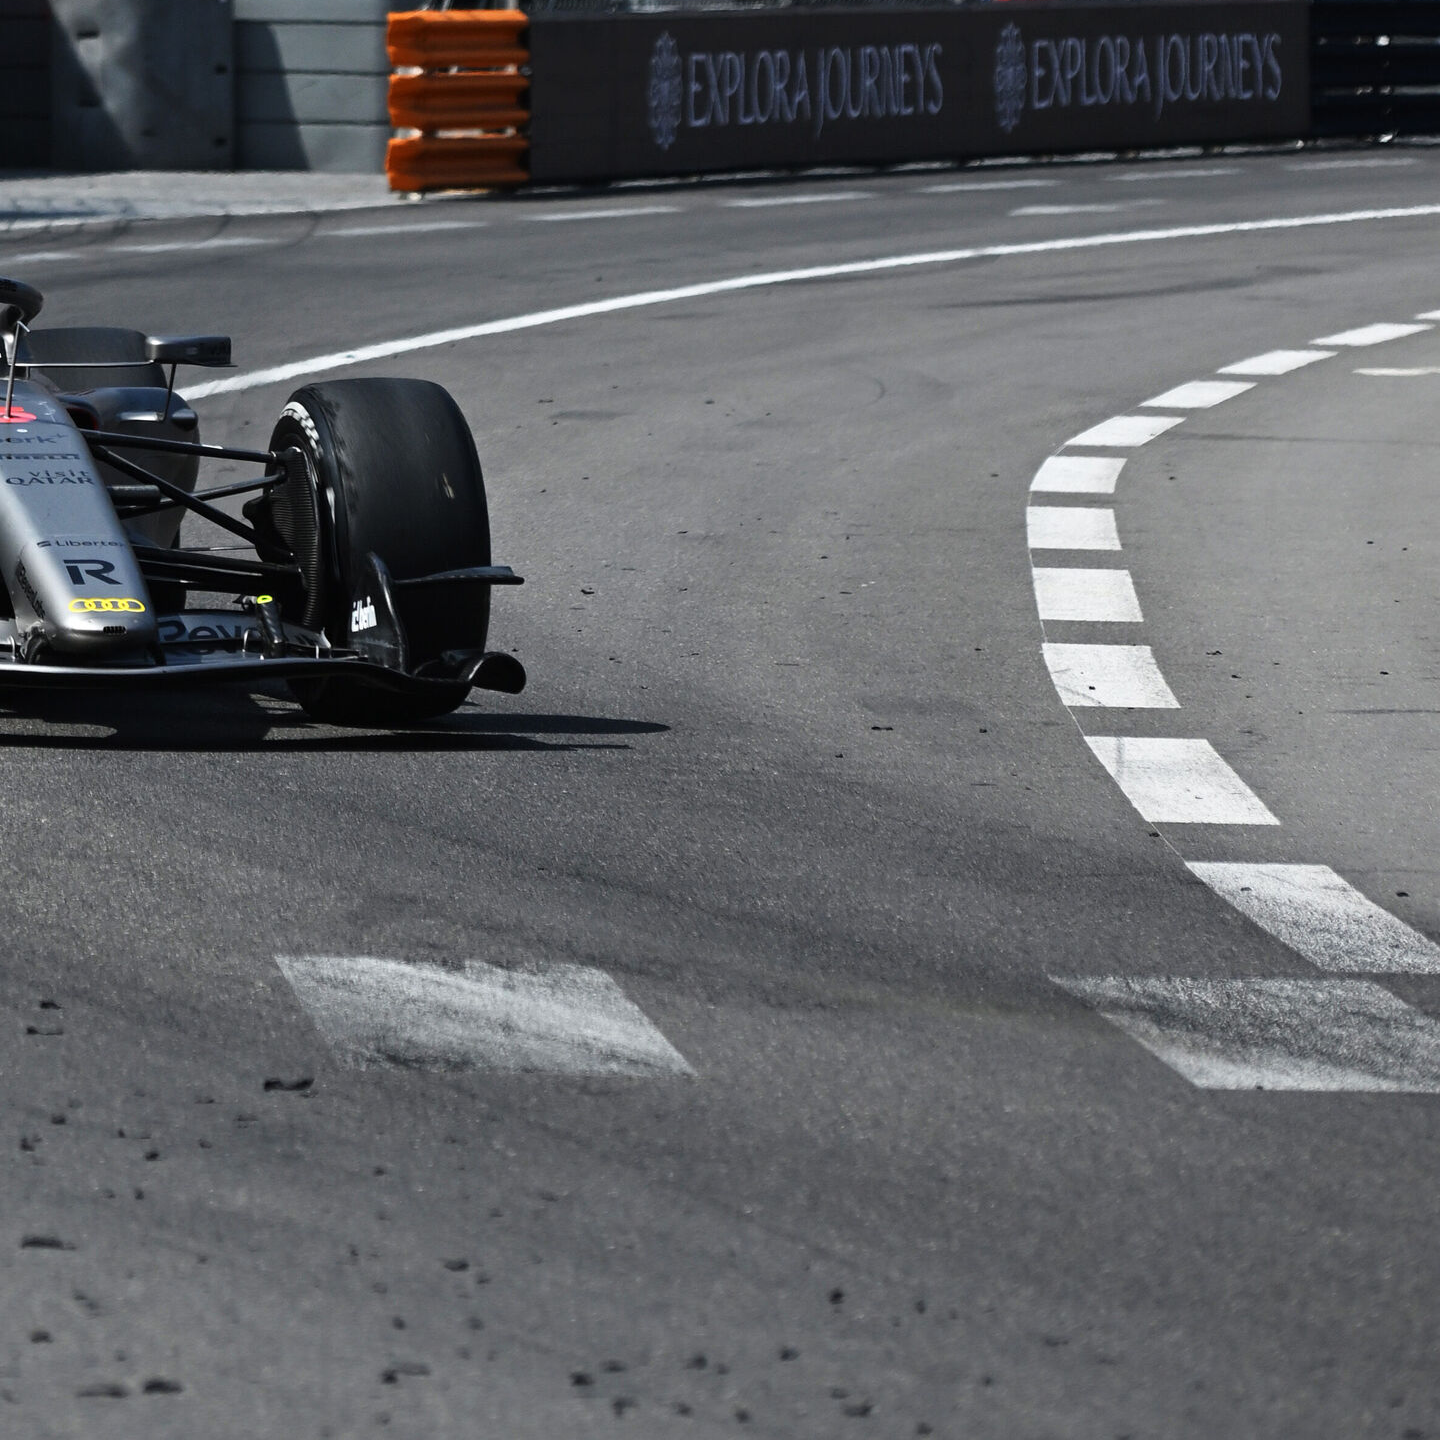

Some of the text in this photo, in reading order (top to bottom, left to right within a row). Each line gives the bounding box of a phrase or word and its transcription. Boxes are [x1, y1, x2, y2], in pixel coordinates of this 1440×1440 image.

[688, 43, 944, 135] EXPLORA JOURNEYS
[1033, 32, 1282, 111] EXPLORA JOURNEYS
[6, 477, 95, 486] QATAR
[63, 559, 123, 585] R
